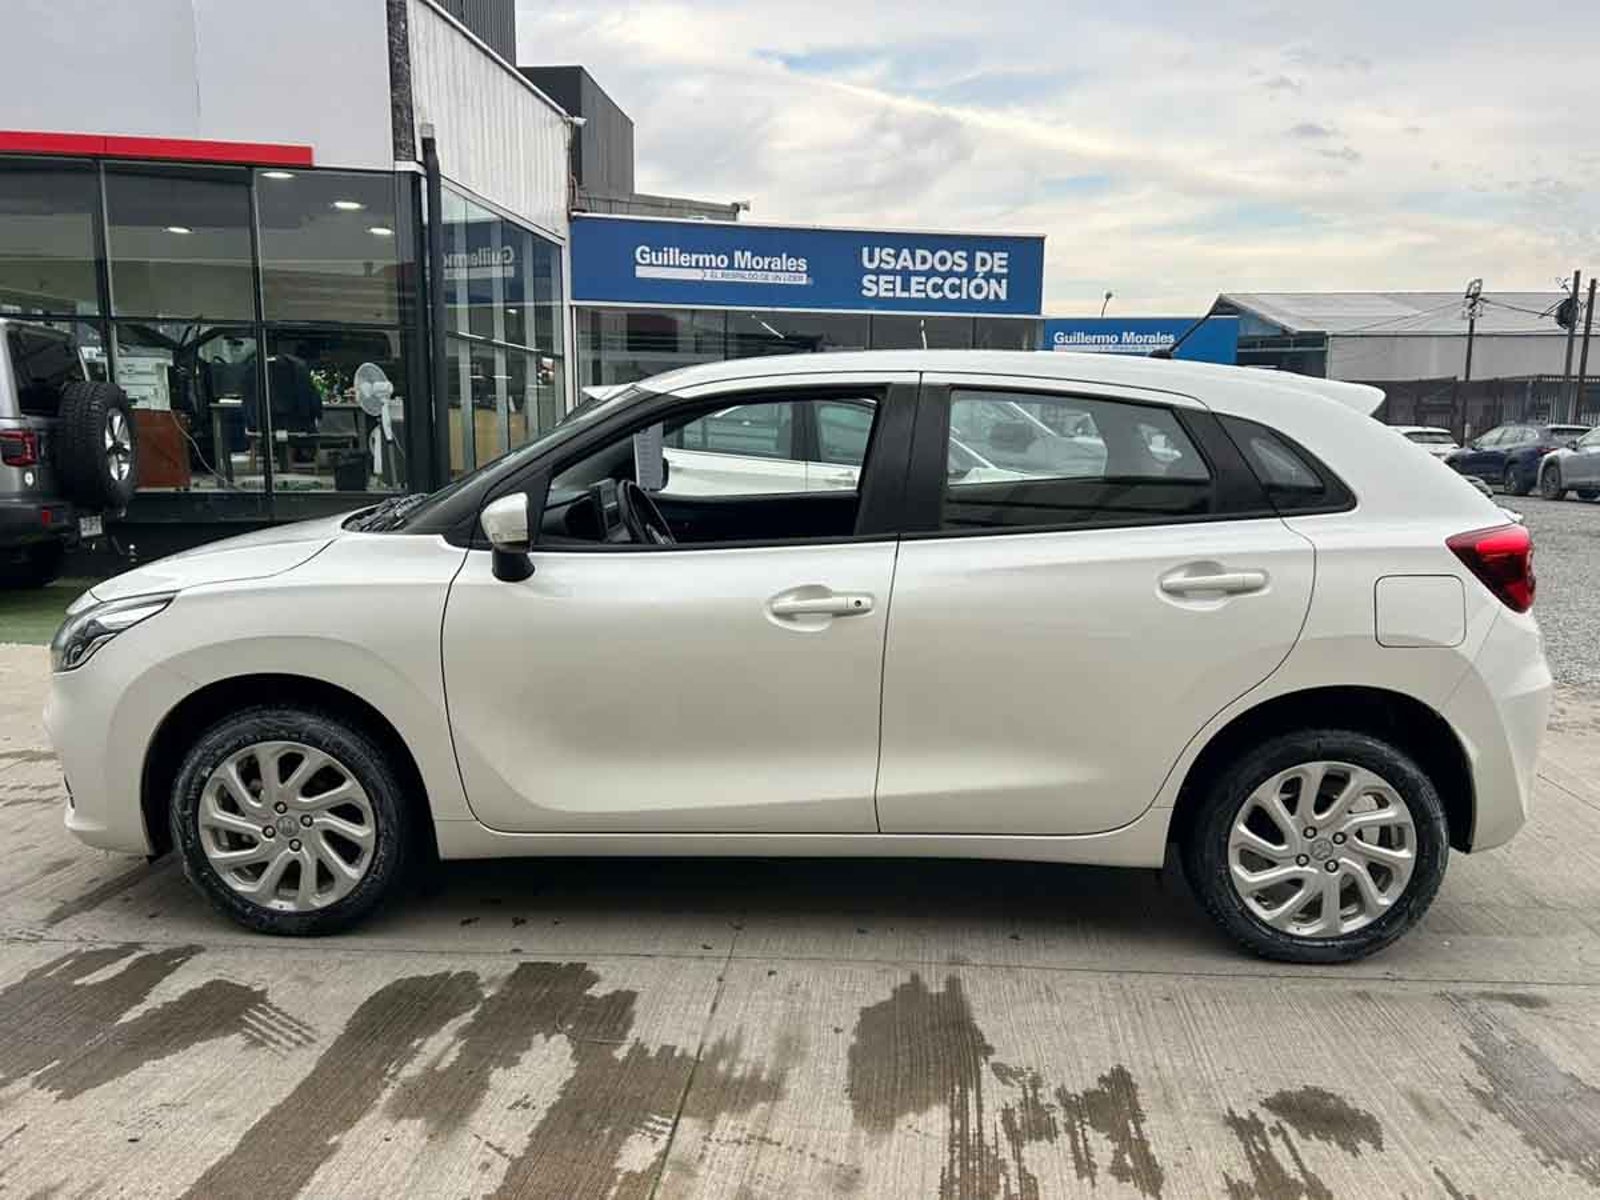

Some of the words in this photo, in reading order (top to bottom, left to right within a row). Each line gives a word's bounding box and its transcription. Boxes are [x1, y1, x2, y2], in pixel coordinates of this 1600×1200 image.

[635, 245, 729, 268] Guillermo
[734, 250, 808, 271] Morales
[861, 246, 969, 272] USADOS
[974, 251, 1009, 273] DE
[861, 273, 1008, 300] SELECCIÓN
[1054, 331, 1119, 344] Guillermo
[1122, 331, 1175, 344] Morales
